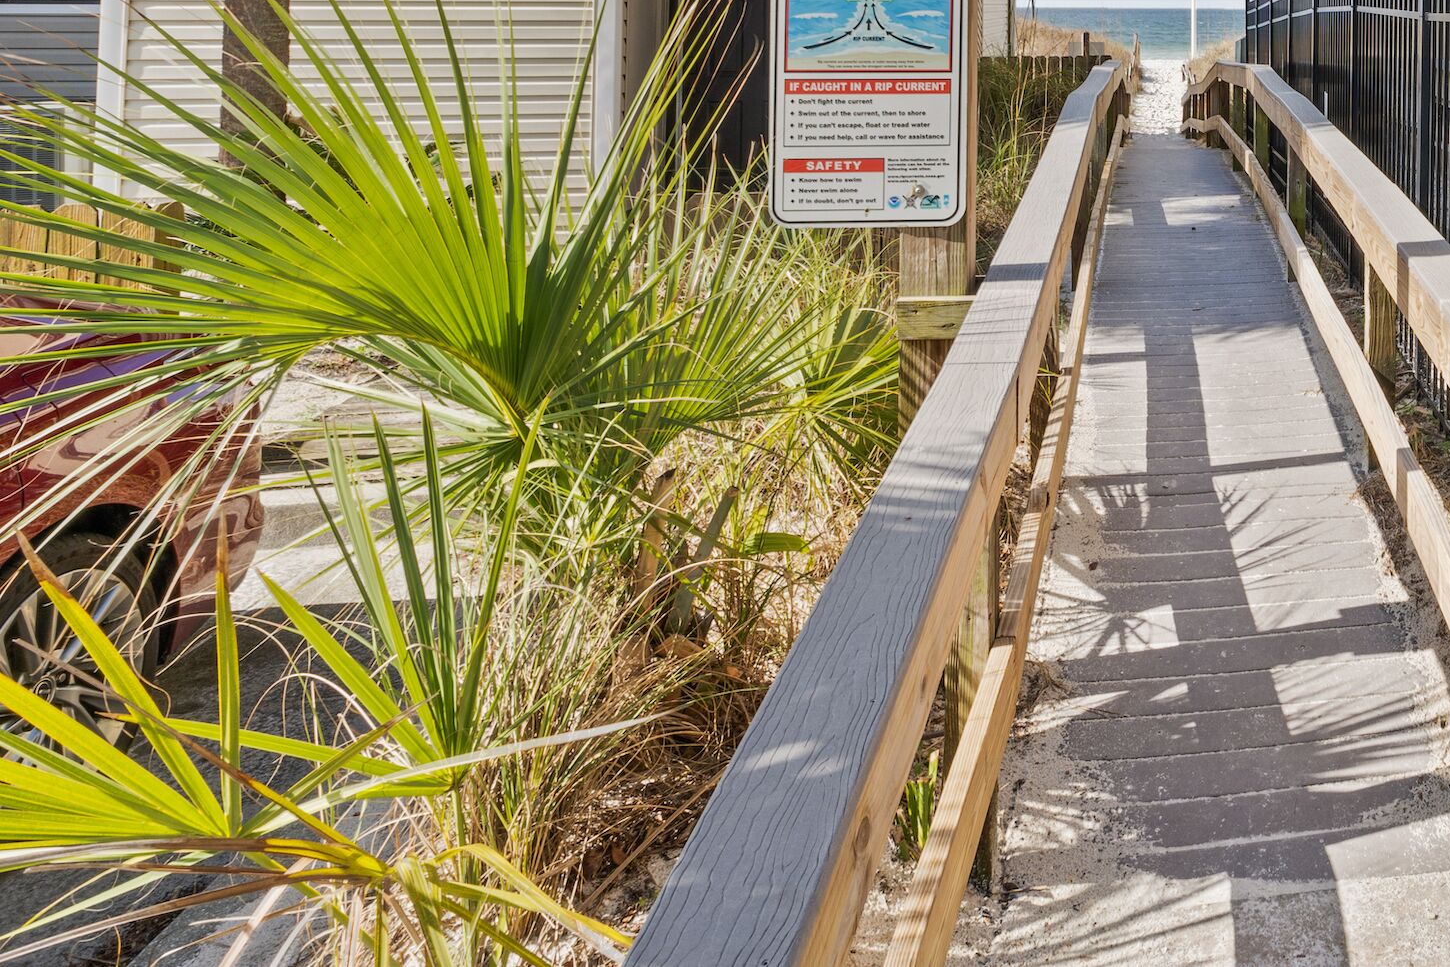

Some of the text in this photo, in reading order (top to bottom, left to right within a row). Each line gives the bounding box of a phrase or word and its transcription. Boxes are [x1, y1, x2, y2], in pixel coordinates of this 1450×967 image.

[789, 82, 946, 91] IF CAUGHT IN A RIP CURRENT
[806, 161, 862, 170] SAFETY
